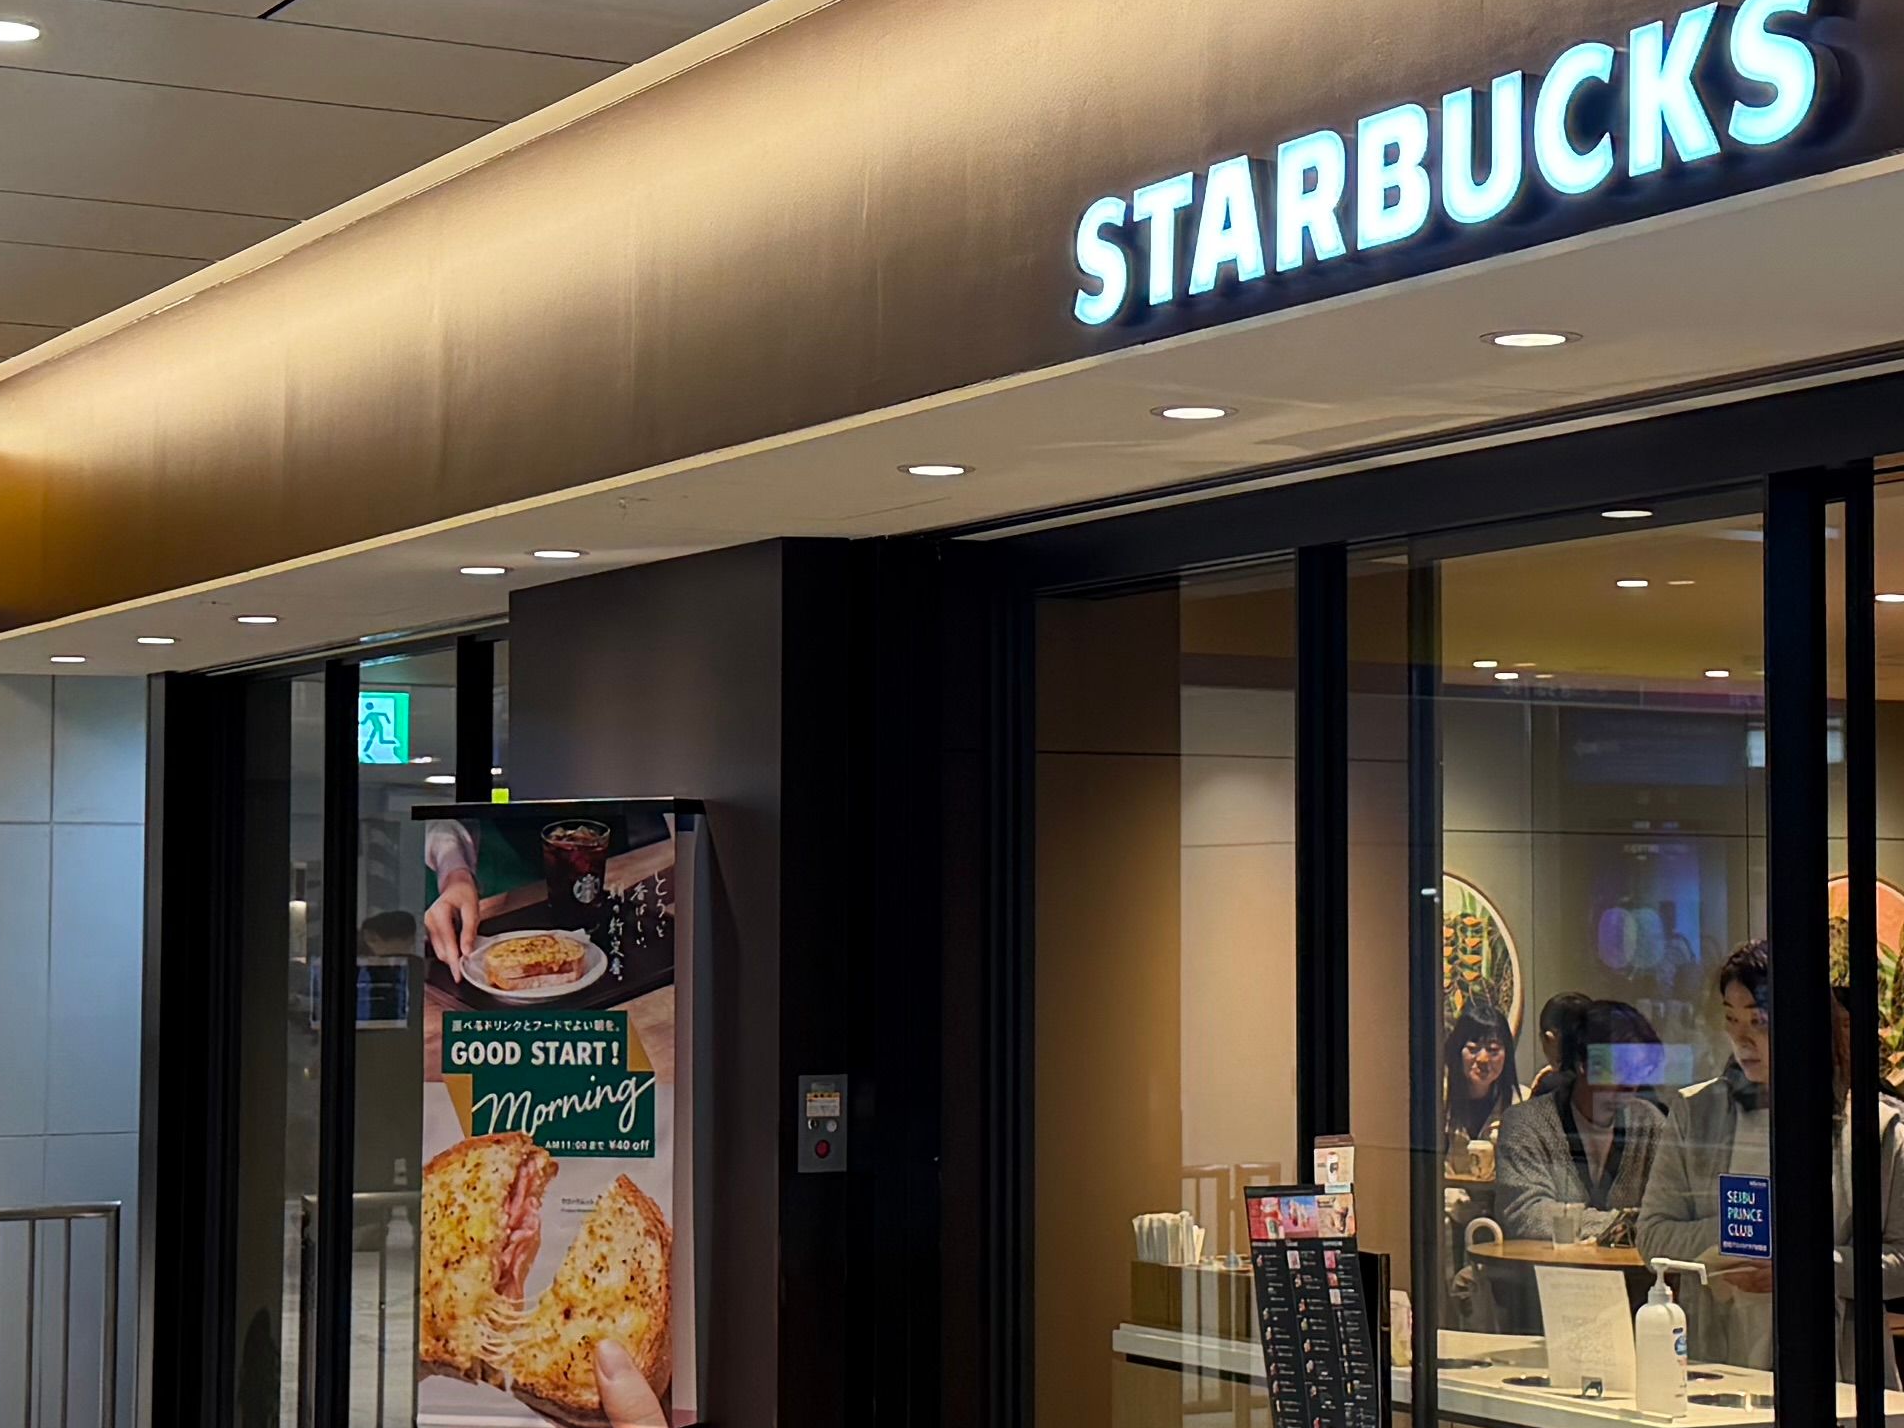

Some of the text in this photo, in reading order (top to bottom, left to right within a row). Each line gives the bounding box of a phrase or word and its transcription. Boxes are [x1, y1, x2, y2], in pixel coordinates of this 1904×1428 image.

[451, 1041, 621, 1066] GOOD START!
[471, 1075, 656, 1137] Morning
[1727, 1206, 1764, 1223] PRINCE
[1727, 1223, 1754, 1238] CLUB
